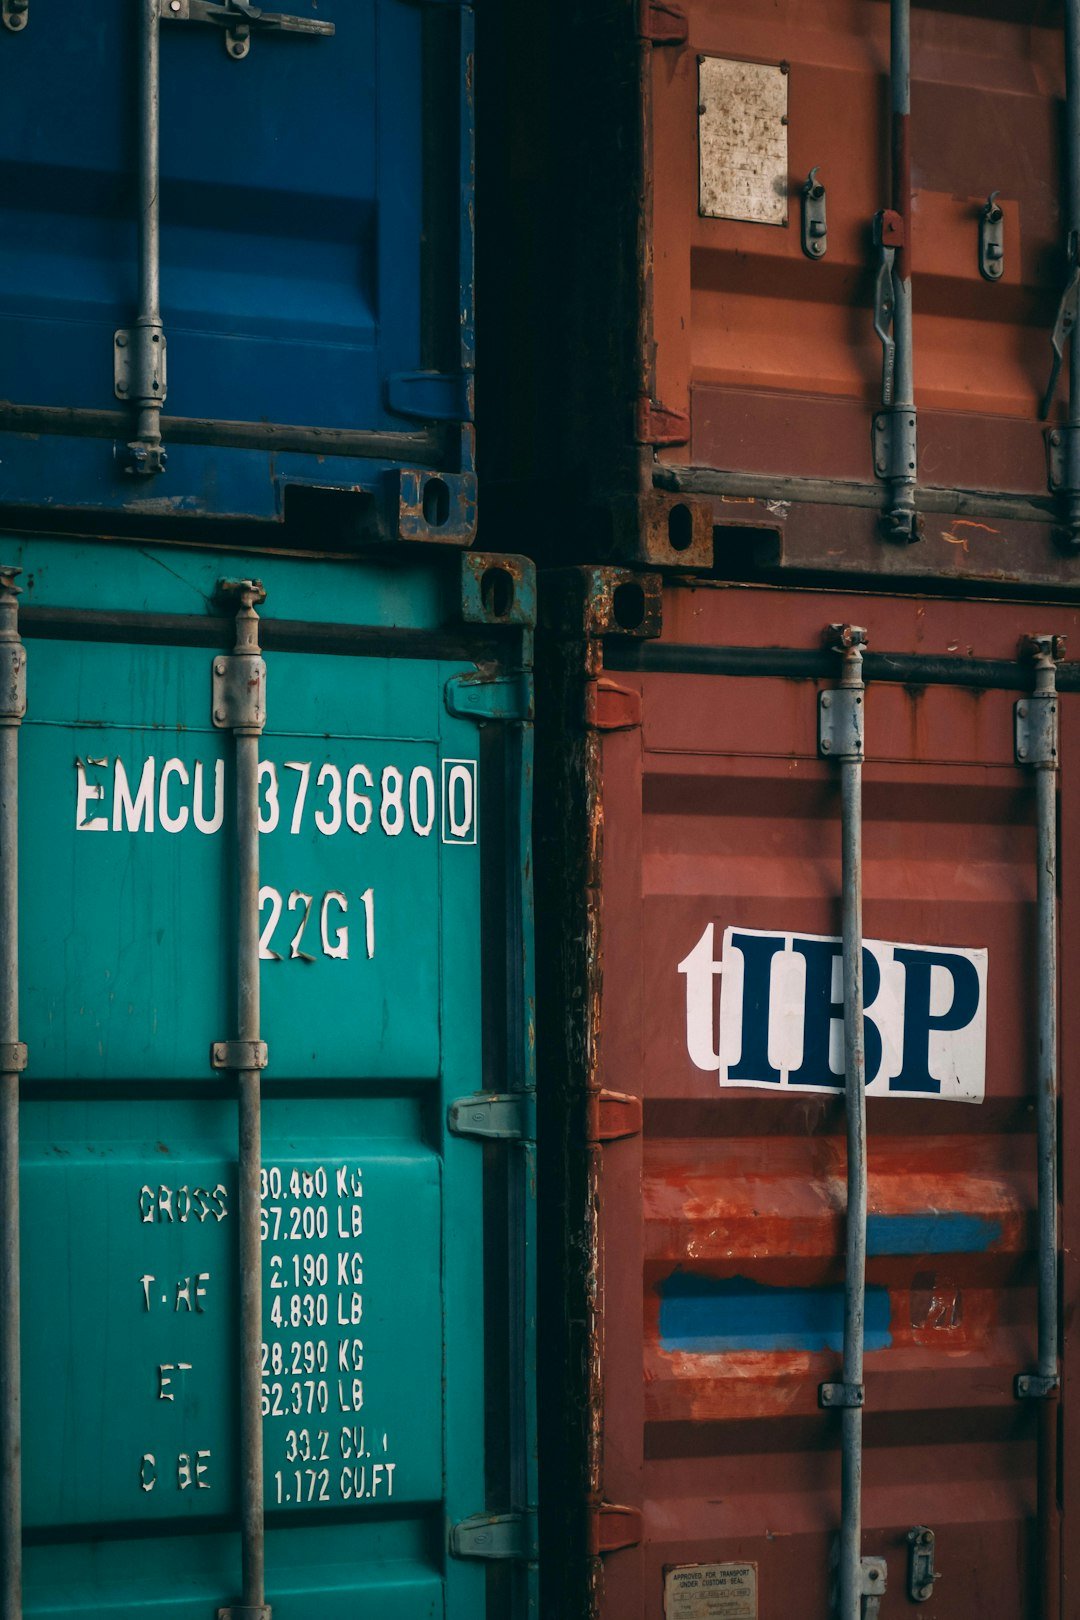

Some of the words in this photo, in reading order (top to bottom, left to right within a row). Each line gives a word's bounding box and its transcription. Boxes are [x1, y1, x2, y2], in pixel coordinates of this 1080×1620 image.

[75, 755, 225, 834] EMCU
[258, 885, 375, 961] 22G1
[337, 1165, 363, 1199] KG
[140, 1184, 228, 1223] GROSS
[338, 1204, 363, 1239] LB
[338, 1252, 363, 1285] KG
[338, 1292, 363, 1325] LB
[339, 1338, 364, 1371] KG
[339, 1379, 364, 1412] LB
[286, 1429, 330, 1463] 33.2
[141, 1450, 211, 1492] CBE
[340, 1463, 396, 1500] CU.FT
[673, 1572, 702, 1580] APPROVED
[719, 1569, 750, 1577] TRANSPORT
[679, 1580, 698, 1588] UNDER
[702, 1578, 727, 1586] CUSTOMS
